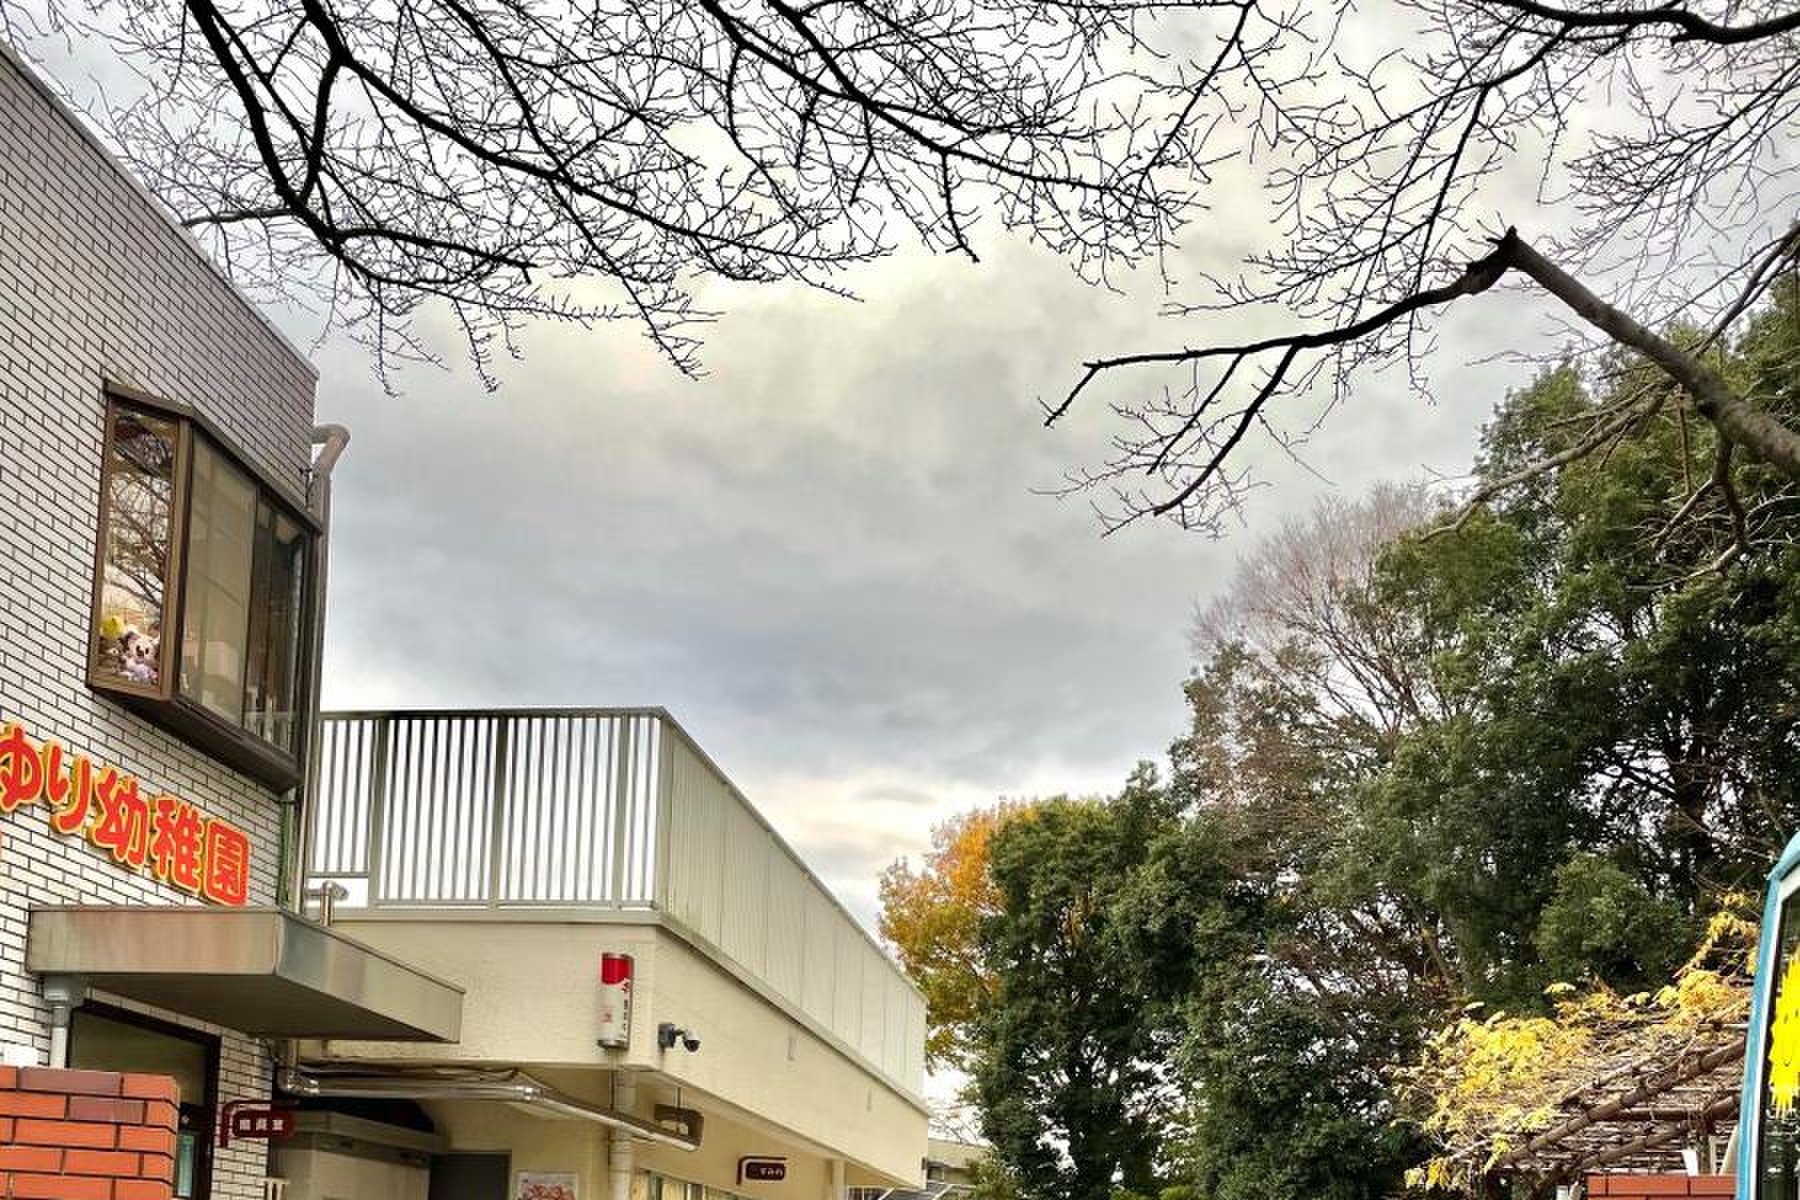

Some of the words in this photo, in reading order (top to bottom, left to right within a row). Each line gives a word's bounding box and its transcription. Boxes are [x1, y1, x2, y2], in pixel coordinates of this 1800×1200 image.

[0, 722, 251, 908] ゆり幼稚園
